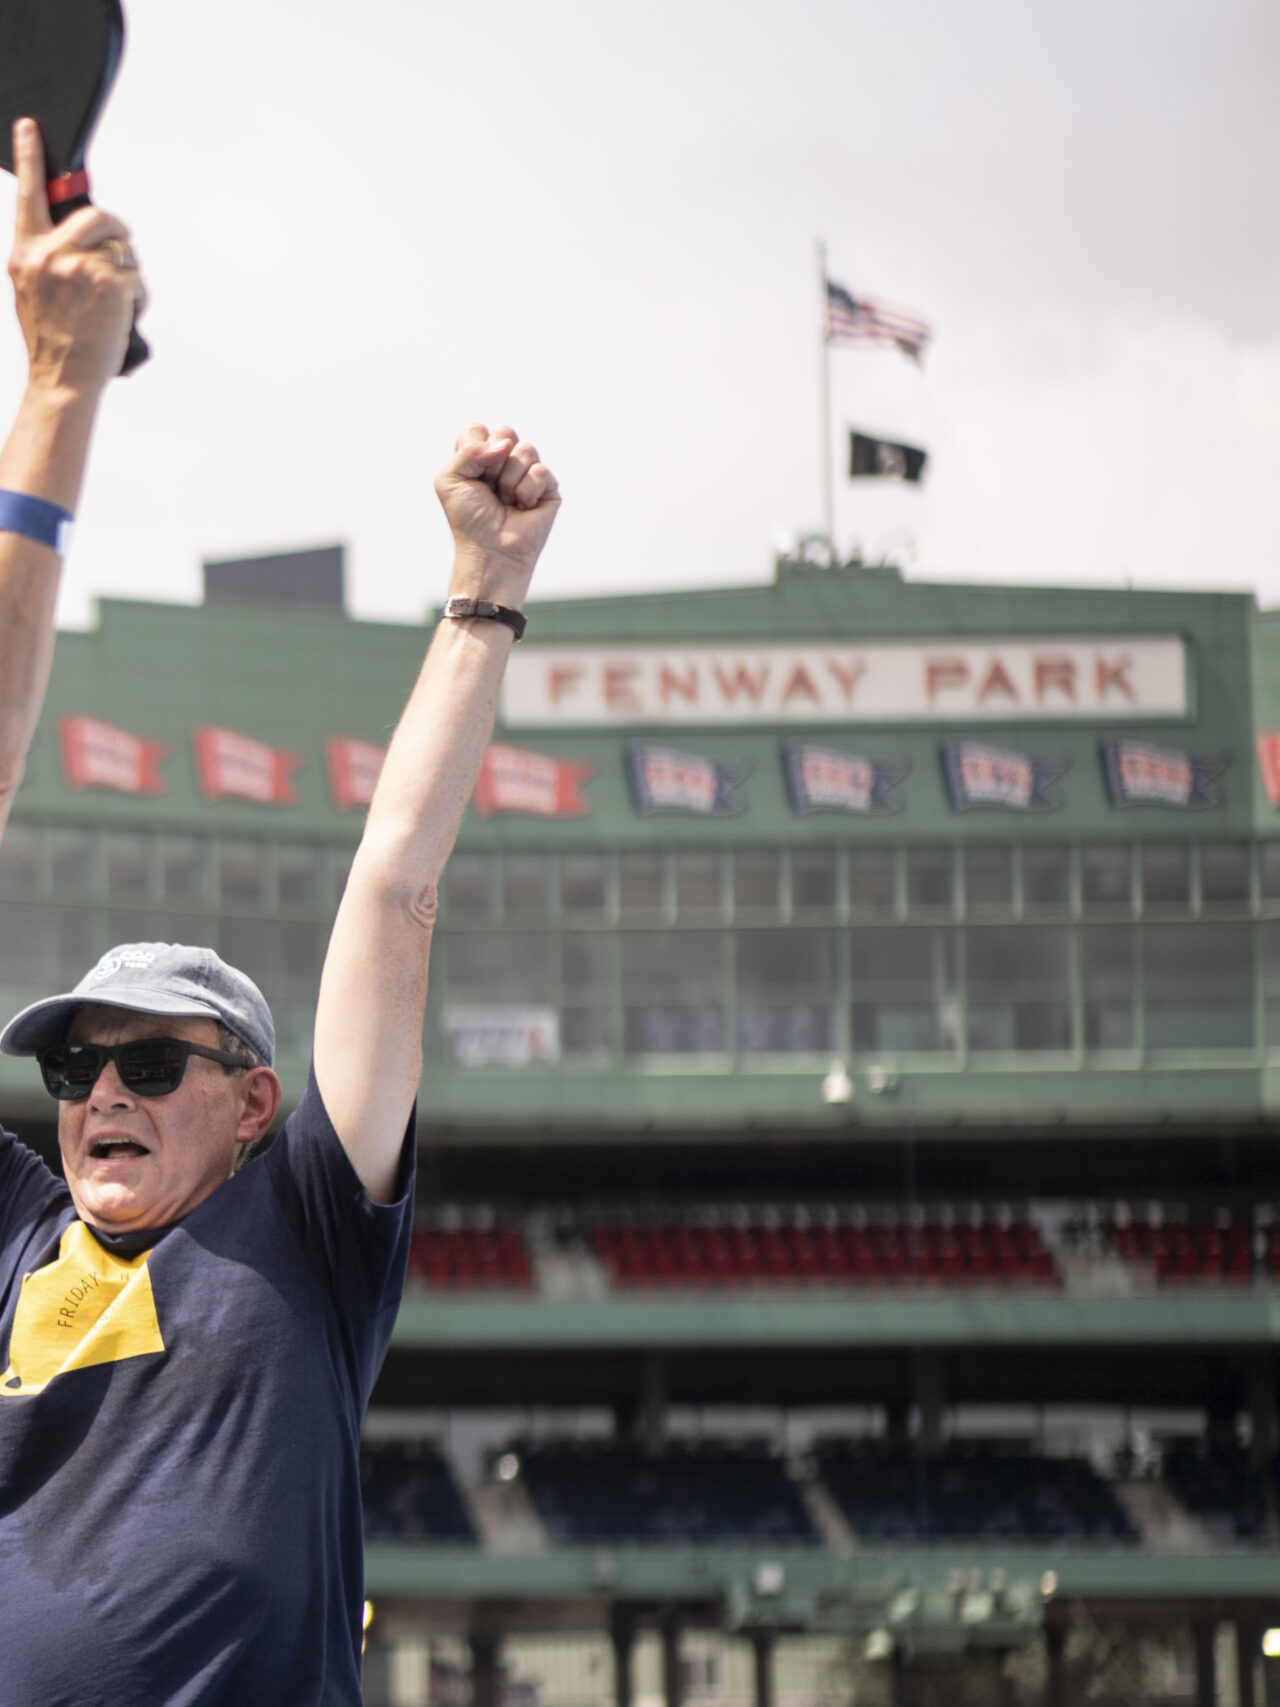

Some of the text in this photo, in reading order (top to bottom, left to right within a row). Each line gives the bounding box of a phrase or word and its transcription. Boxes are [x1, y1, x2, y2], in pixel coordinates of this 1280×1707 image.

[548, 655, 1137, 708] FENWAY PARK
[57, 1272, 100, 1328] FRIDAY
